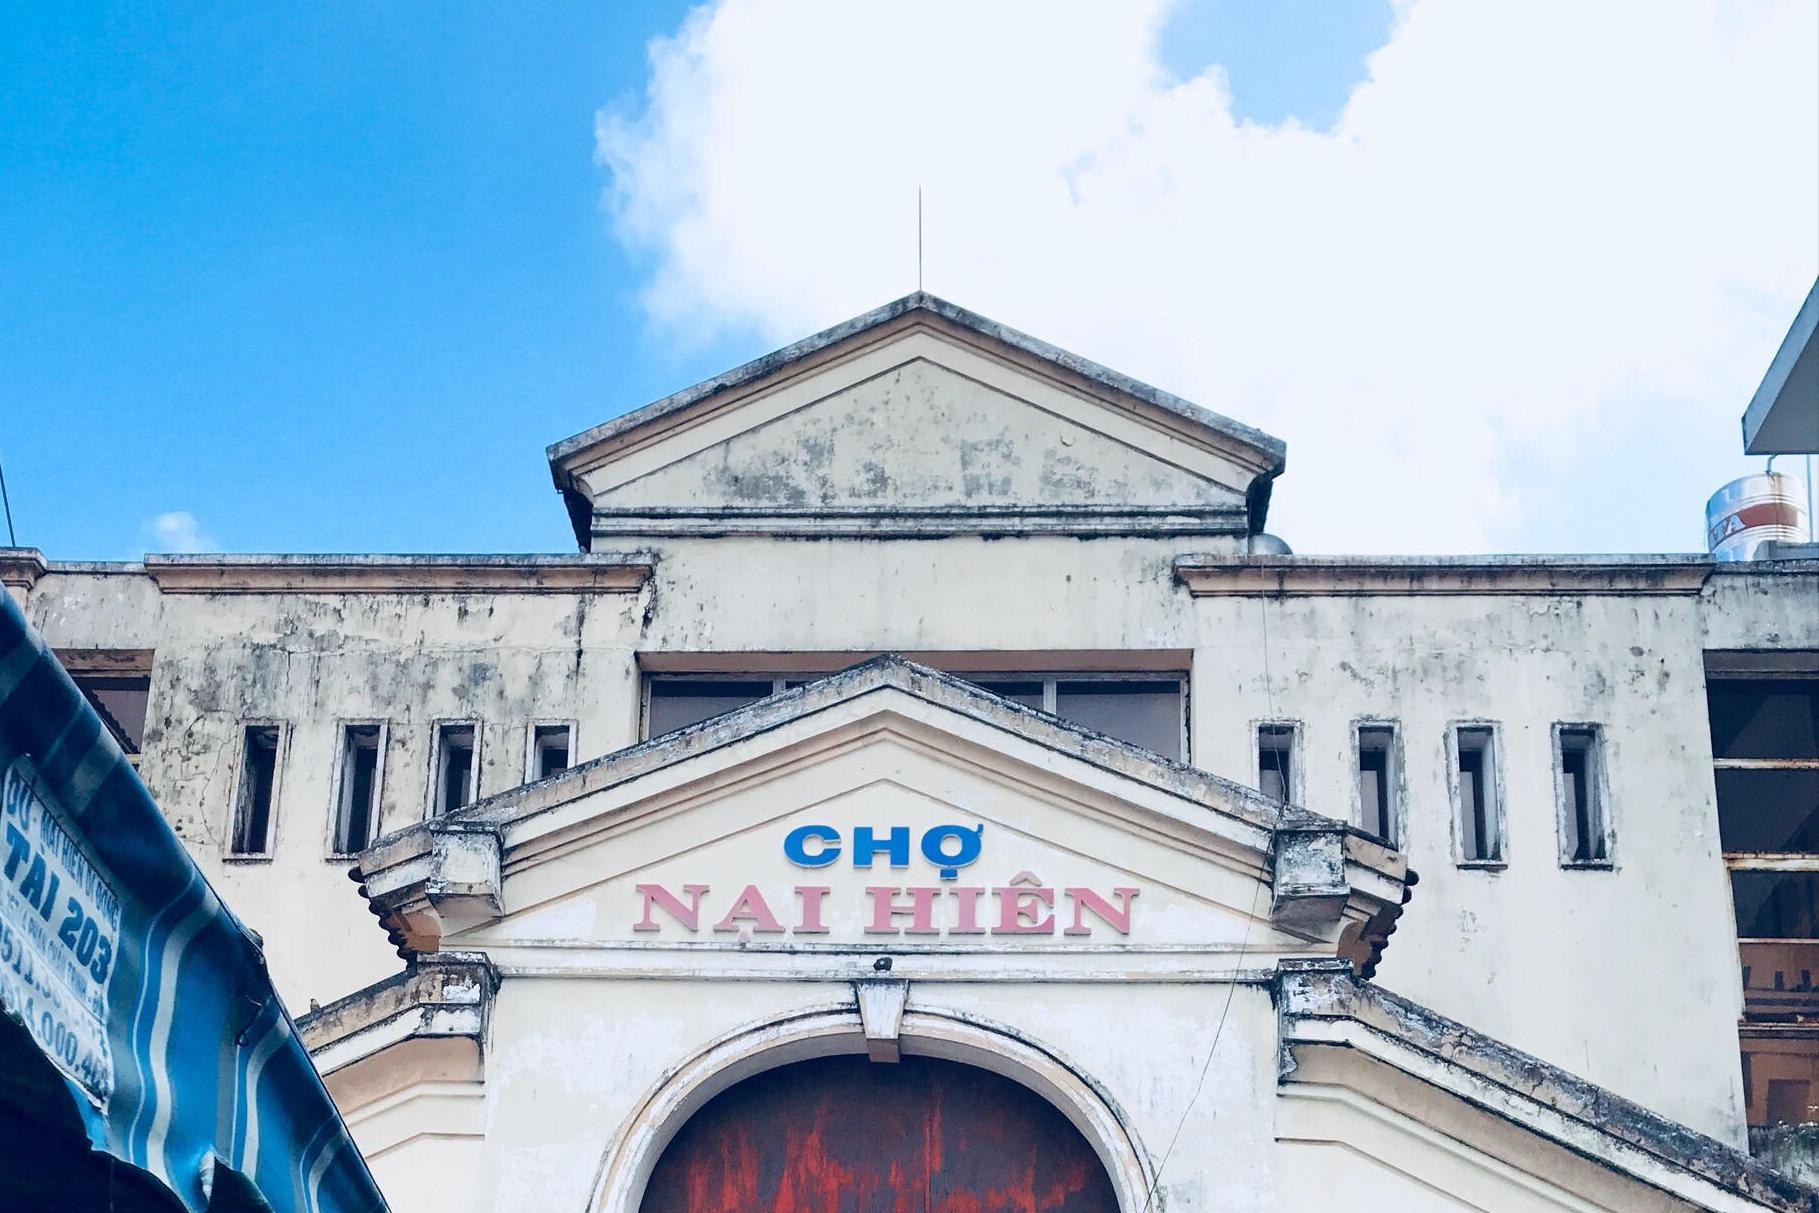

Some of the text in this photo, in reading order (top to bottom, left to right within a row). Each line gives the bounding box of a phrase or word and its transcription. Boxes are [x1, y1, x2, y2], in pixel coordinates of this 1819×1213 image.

[783, 824, 984, 879] CHỢ
[4, 820, 60, 922] TÀI
[58, 895, 112, 985] 203
[633, 870, 1141, 943] NẠI HIÊN
